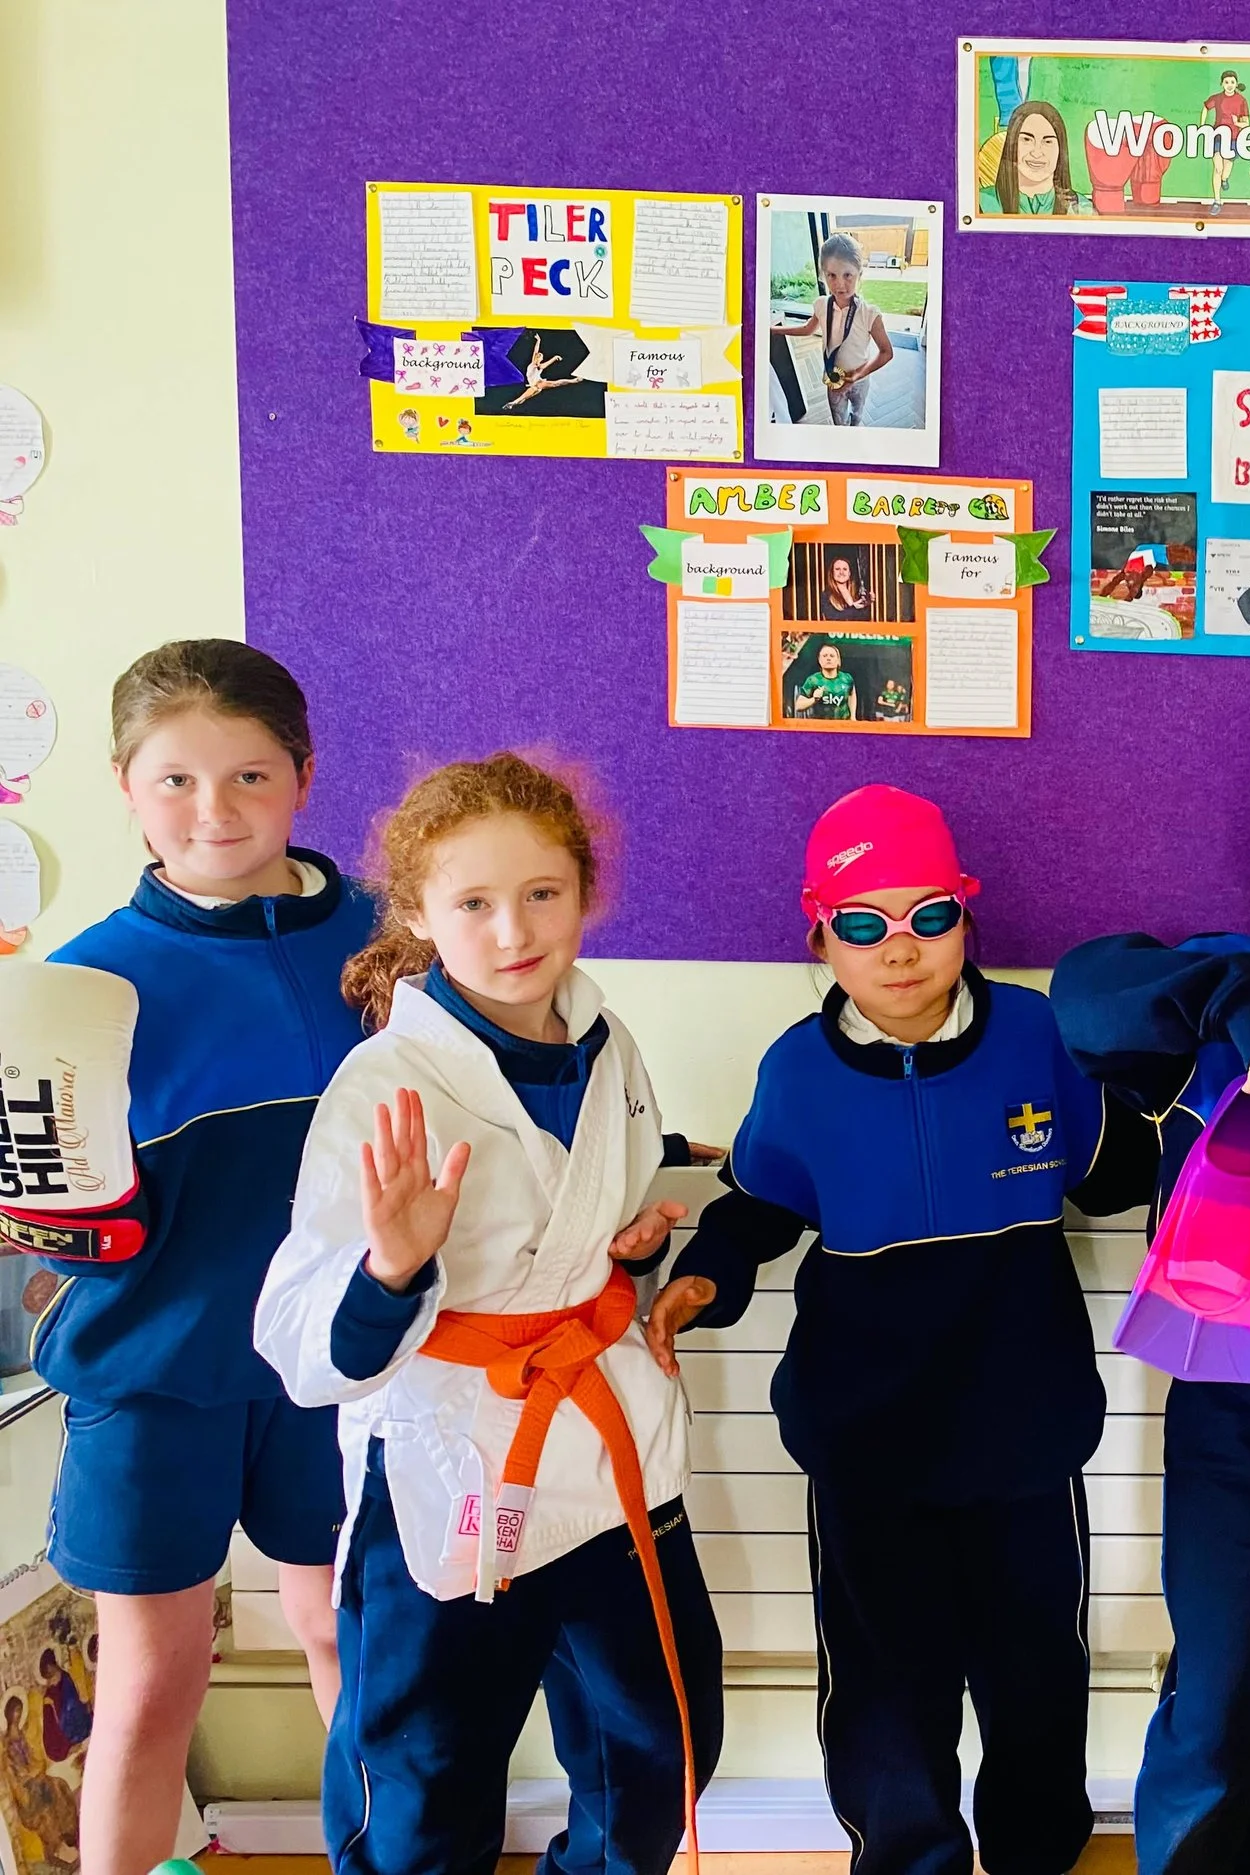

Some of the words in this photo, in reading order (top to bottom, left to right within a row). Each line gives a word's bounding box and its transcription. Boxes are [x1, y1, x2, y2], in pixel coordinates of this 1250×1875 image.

[489, 203, 607, 242] TILER
[490, 257, 608, 299] PECK
[1114, 320, 1184, 330] BACKGROUND
[629, 349, 685, 362] Famous
[402, 356, 483, 372] background
[646, 364, 668, 378] for
[689, 483, 820, 516] AMBER
[944, 551, 999, 564] Famous
[686, 563, 765, 577] background
[961, 566, 982, 580] for
[823, 695, 844, 706] sky
[827, 841, 874, 869] speedo
[7, 1079, 69, 1195] HILL
[990, 1169, 1007, 1180] THE
[1008, 1162, 1049, 1176] TERESIAN
